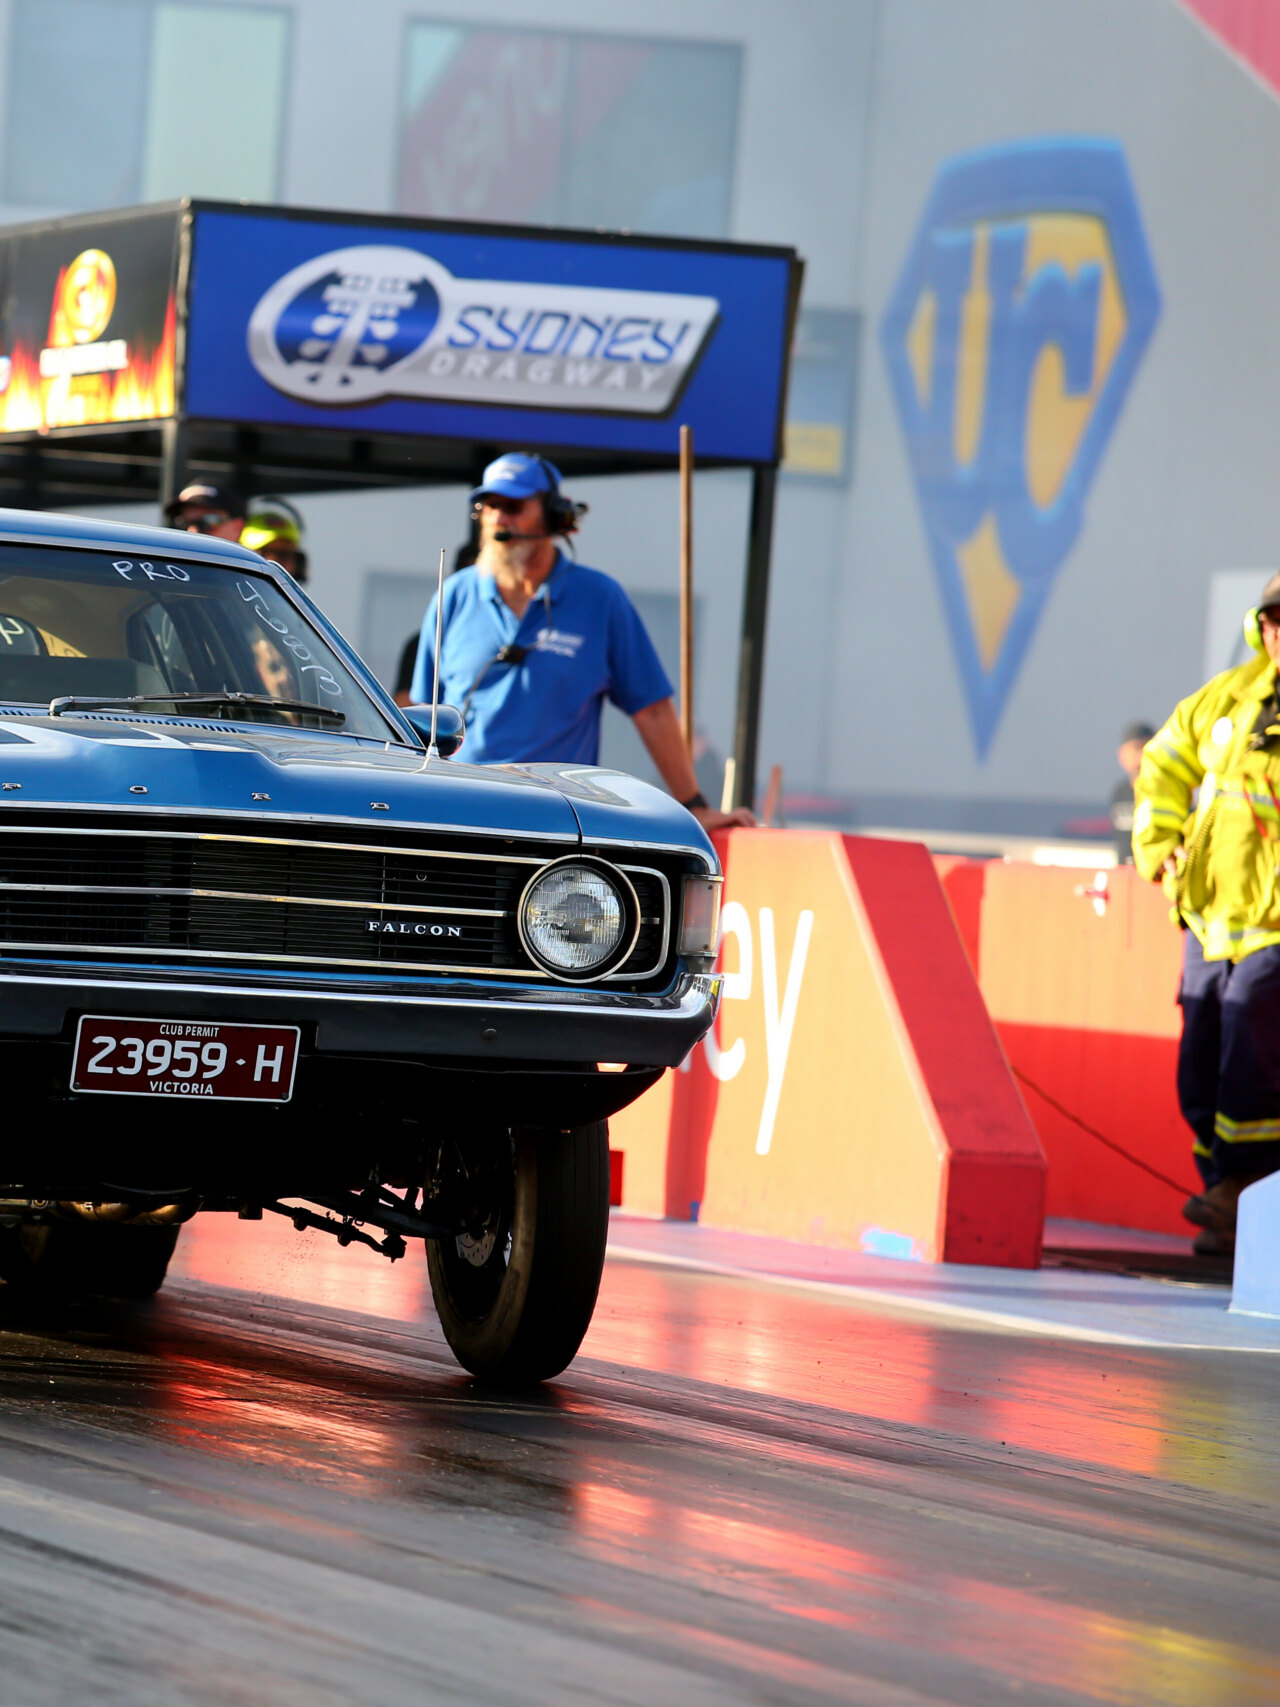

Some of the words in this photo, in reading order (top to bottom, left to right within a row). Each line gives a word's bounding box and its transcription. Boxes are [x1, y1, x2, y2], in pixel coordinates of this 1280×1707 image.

[448, 304, 691, 364] SYDNEY
[428, 349, 666, 391] DRAGWAY
[112, 560, 190, 582] PRO
[368, 921, 462, 937] FALCON
[159, 1024, 183, 1036] CLUB
[185, 1026, 220, 1038] PERMIT
[680, 900, 815, 1156] ey
[149, 1081, 214, 1095] VICTORIA
